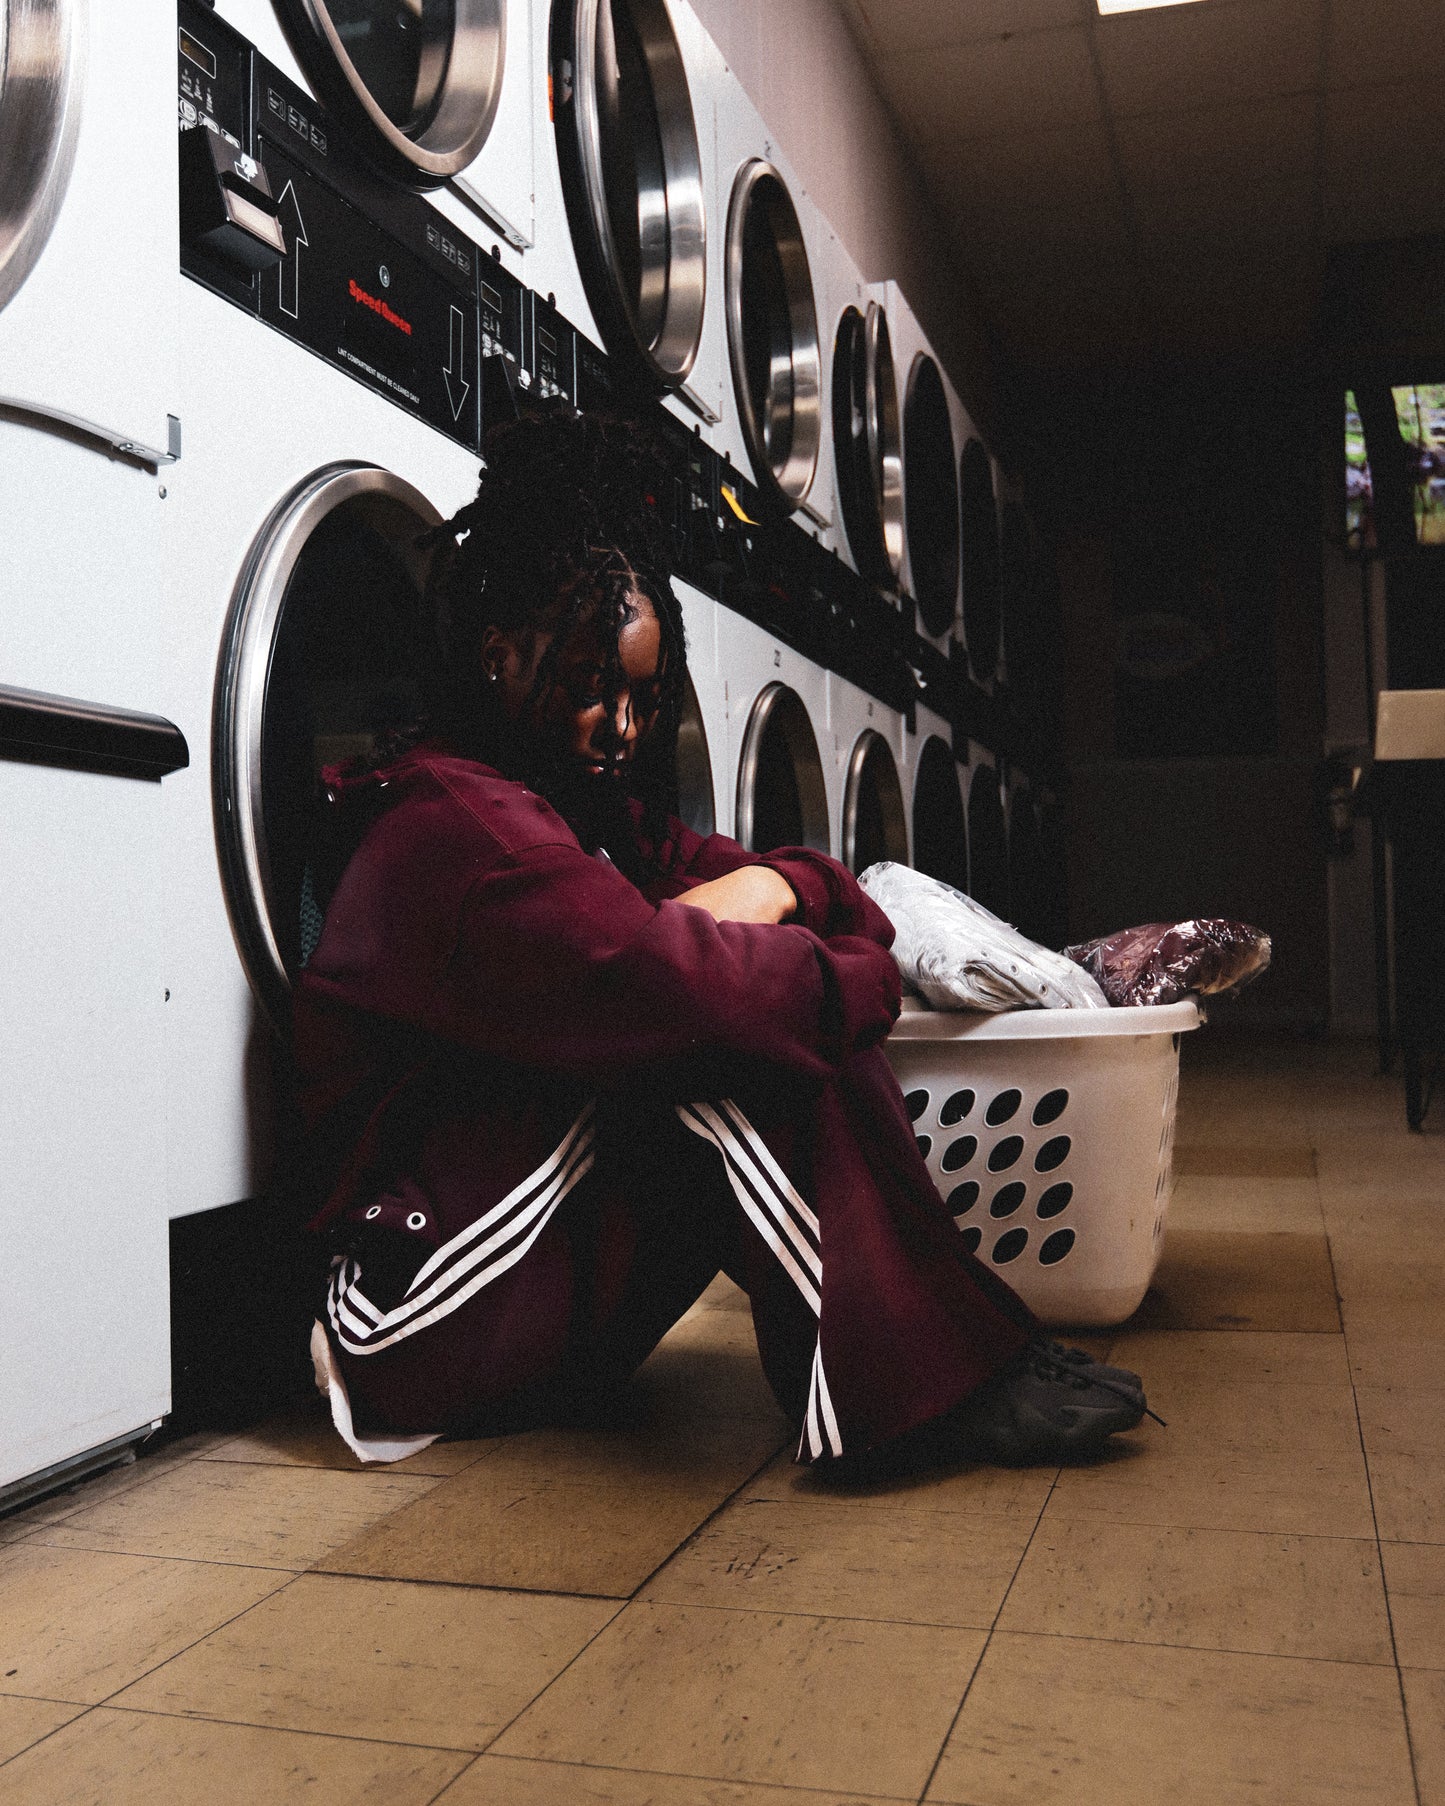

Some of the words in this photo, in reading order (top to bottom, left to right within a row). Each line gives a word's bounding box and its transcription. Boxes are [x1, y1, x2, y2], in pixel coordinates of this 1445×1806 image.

[337, 346, 347, 358] LINT
[376, 370, 387, 384] MUST
[387, 377, 392, 387] BE
[392, 381, 409, 398] CLEANED
[409, 391, 420, 405] DAILY
